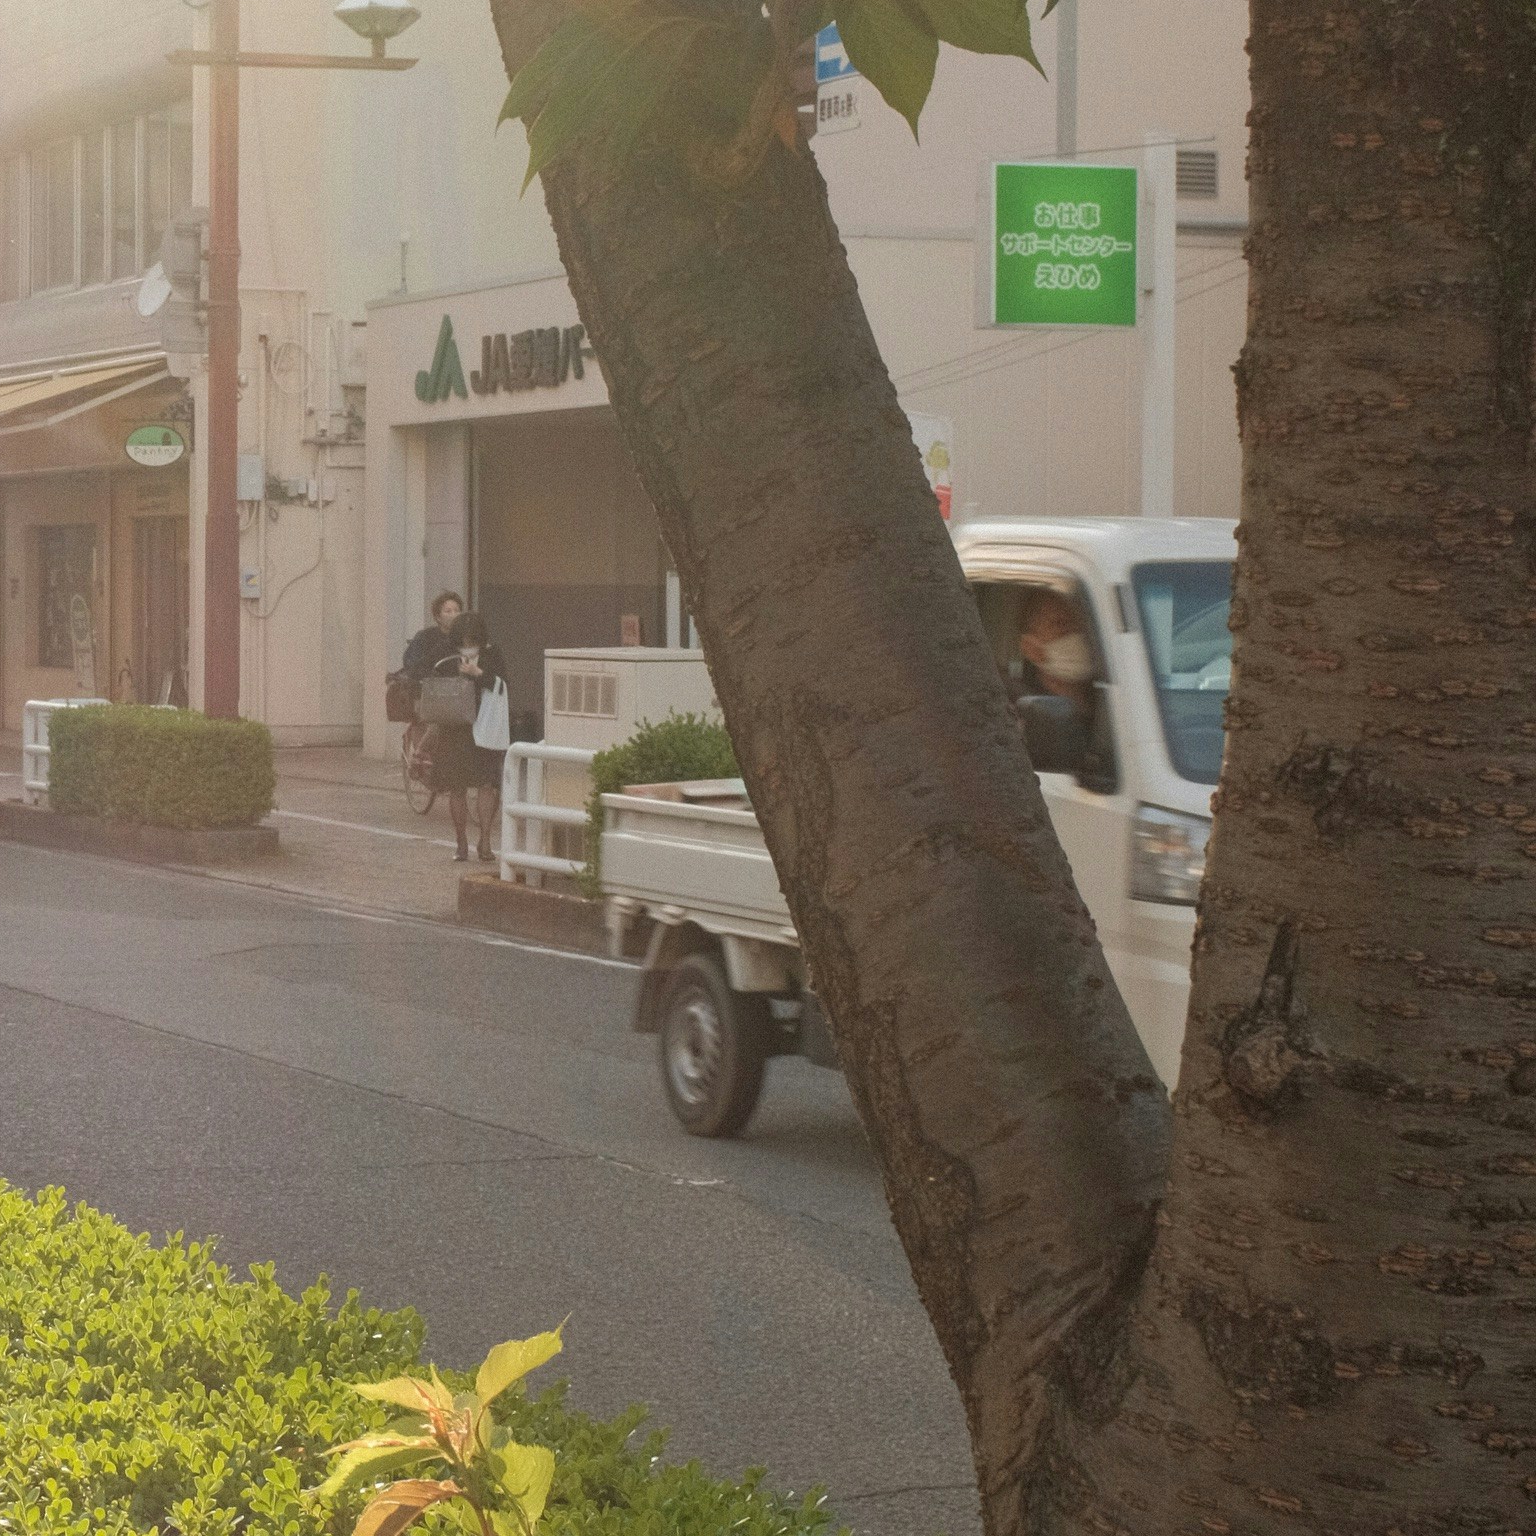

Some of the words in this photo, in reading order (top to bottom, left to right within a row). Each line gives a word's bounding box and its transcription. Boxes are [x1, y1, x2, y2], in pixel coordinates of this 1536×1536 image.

[1034, 202, 1100, 229] お仕事
[1000, 233, 1132, 257] サポートセンター
[1035, 263, 1101, 289] えひめ
